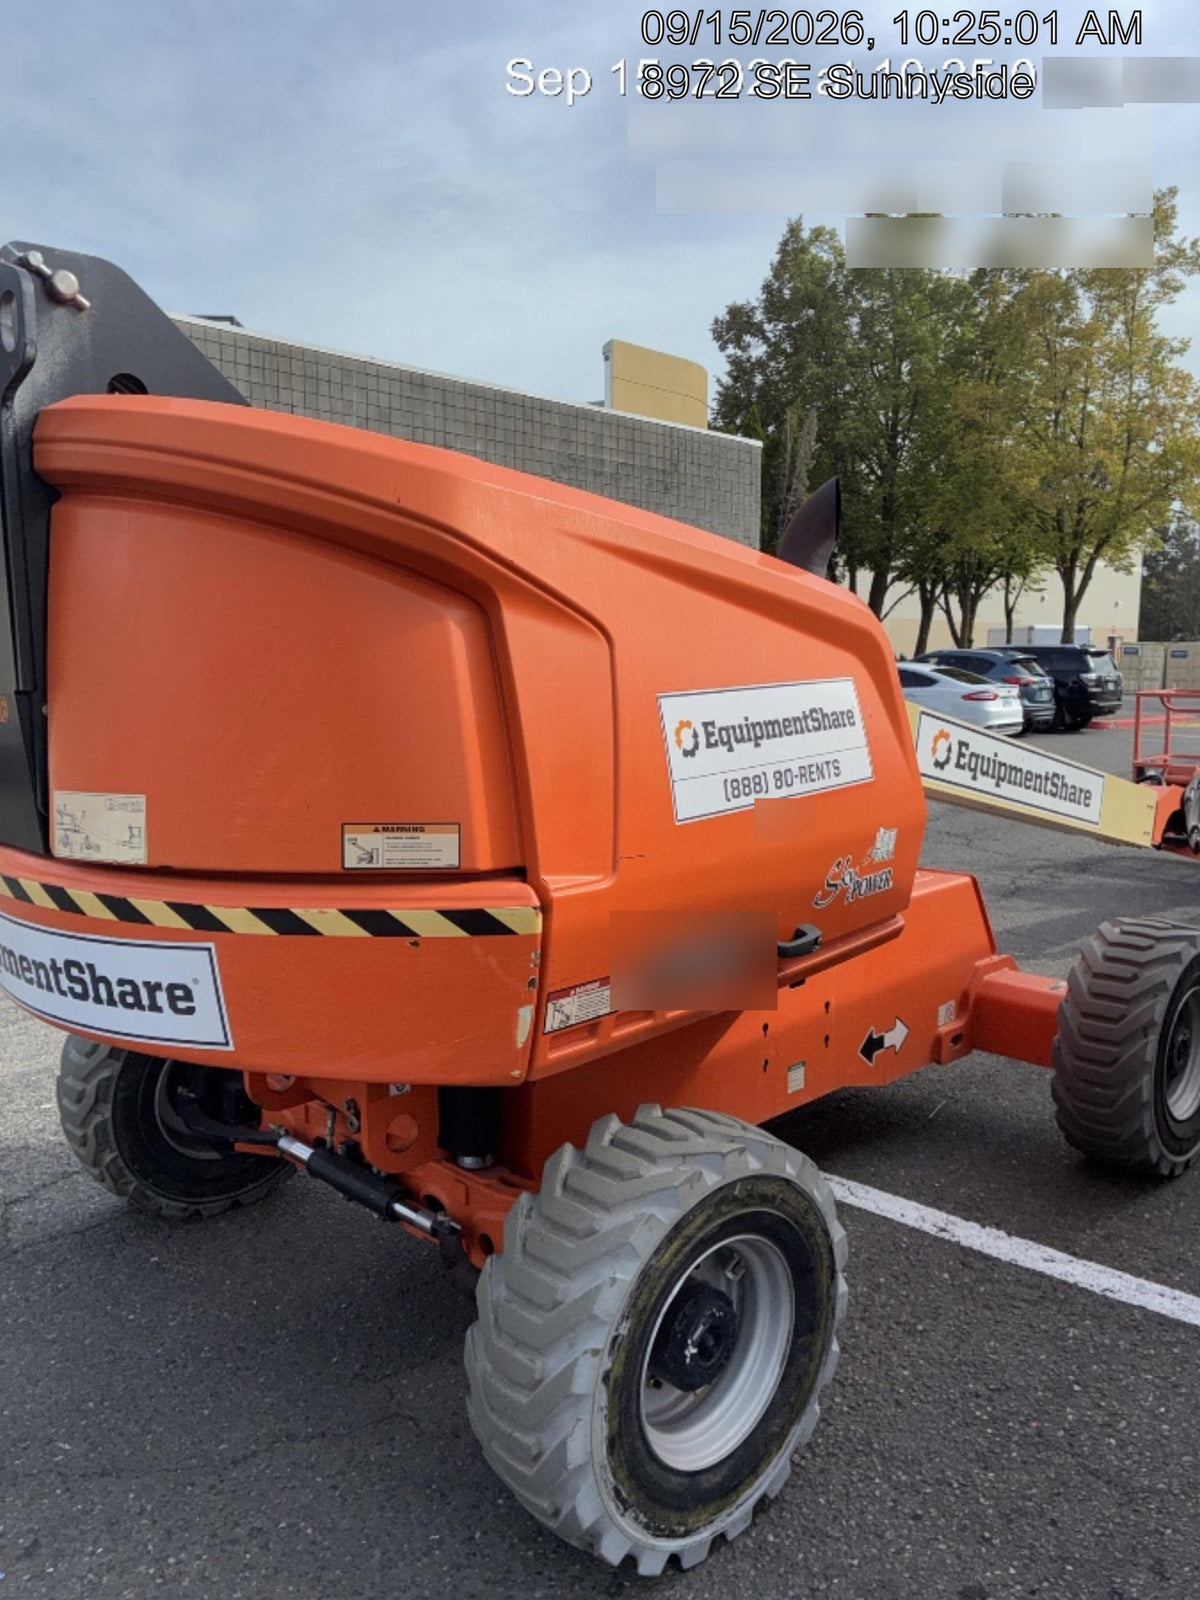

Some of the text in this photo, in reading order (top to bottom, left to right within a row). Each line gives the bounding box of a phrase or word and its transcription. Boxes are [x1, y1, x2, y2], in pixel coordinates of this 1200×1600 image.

[701, 707, 856, 752] EquipmentShare
[723, 758, 842, 802] (888) 80-RENTS
[954, 739, 1093, 808] EquipmentShare
[0, 943, 196, 1016] mentShare
